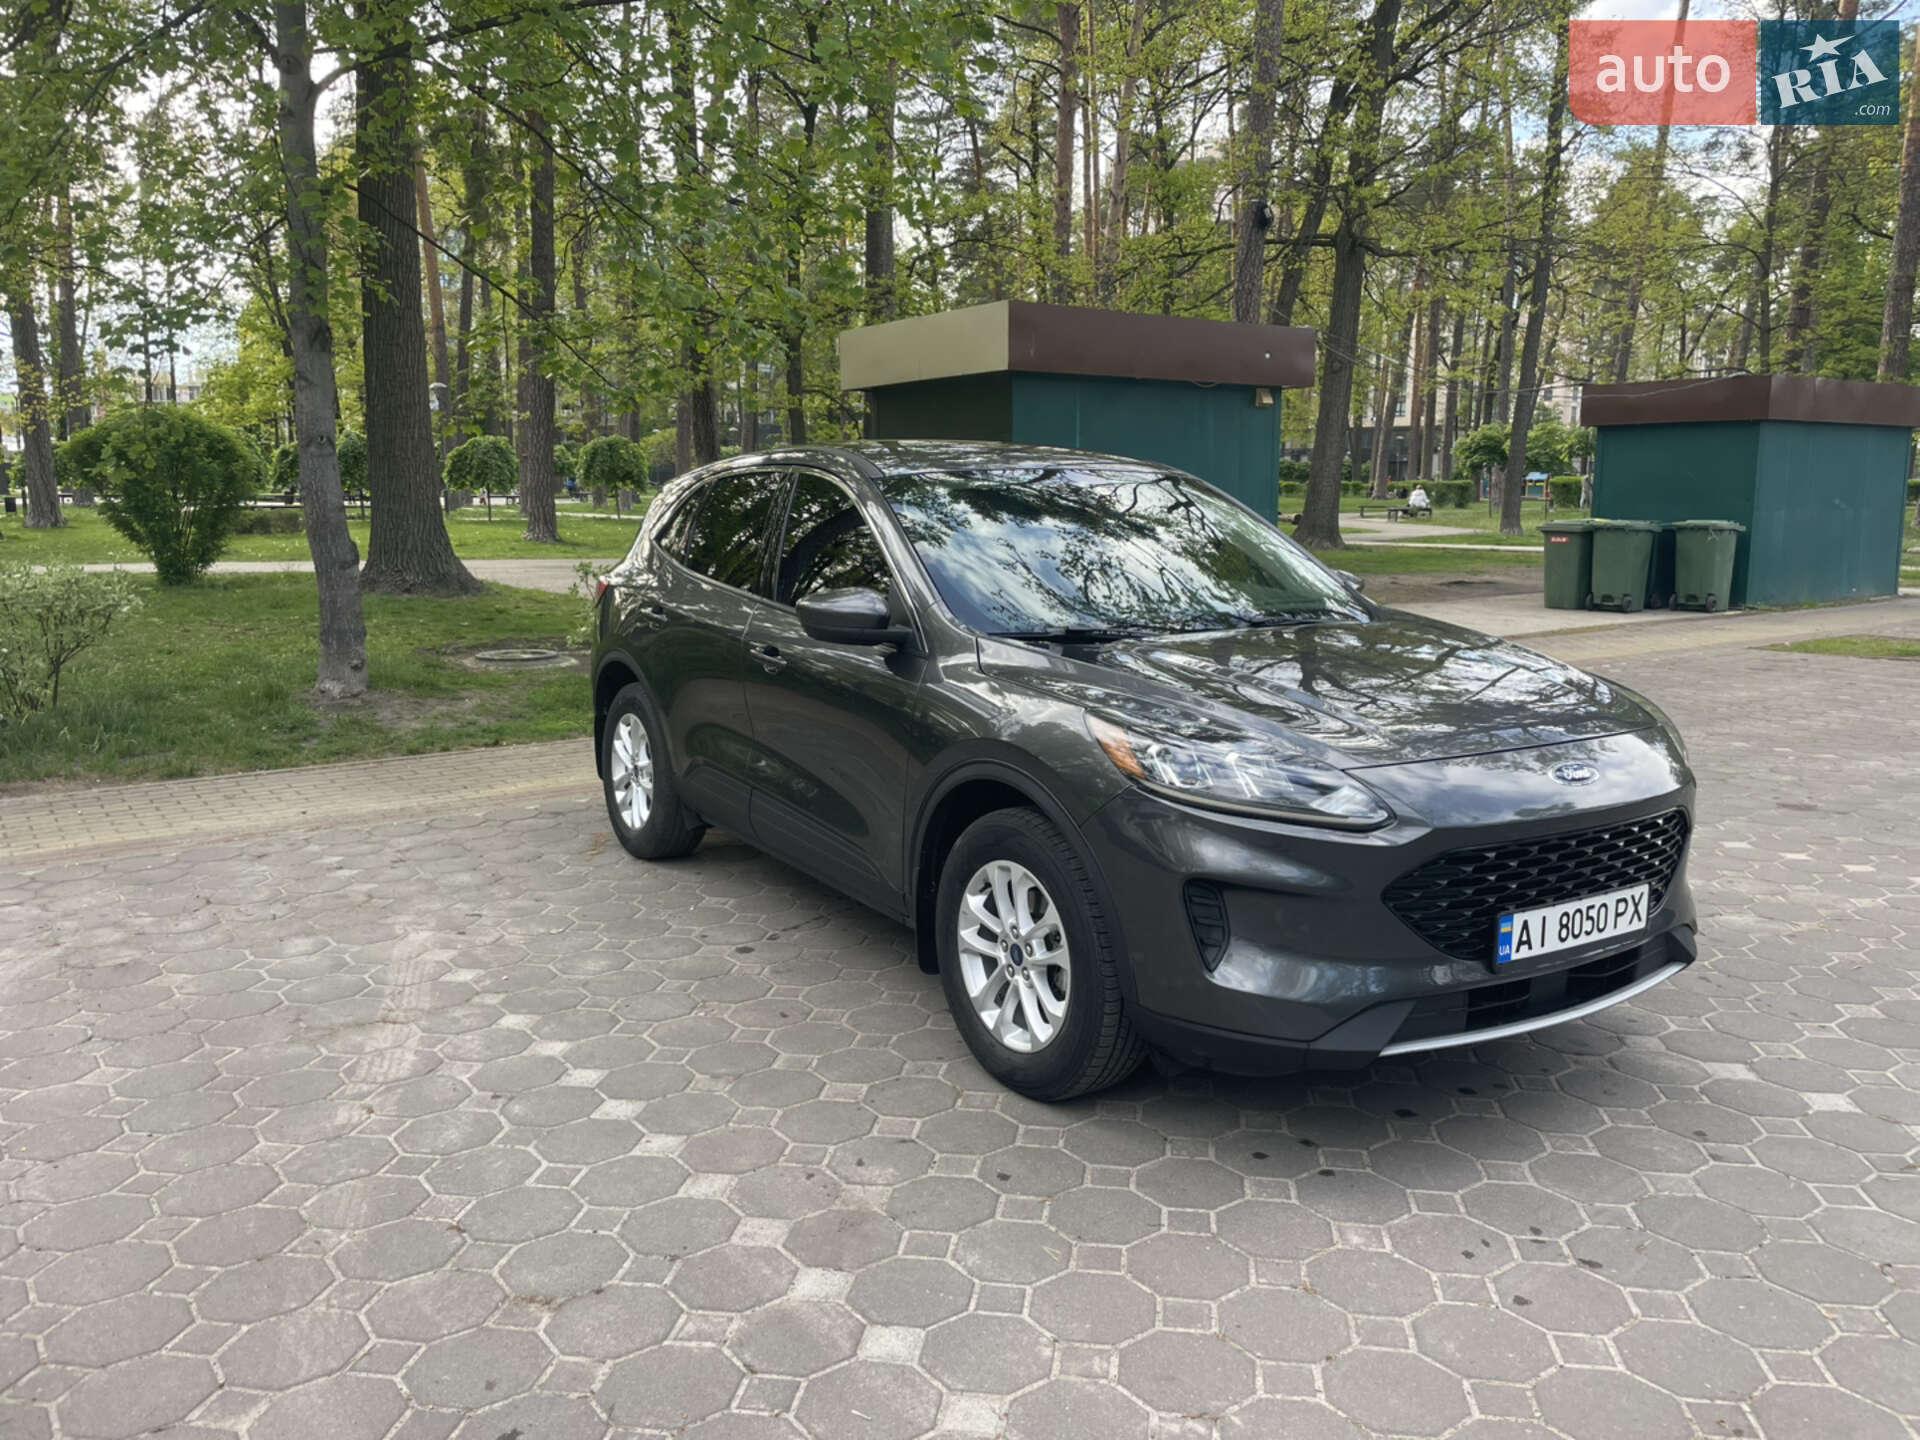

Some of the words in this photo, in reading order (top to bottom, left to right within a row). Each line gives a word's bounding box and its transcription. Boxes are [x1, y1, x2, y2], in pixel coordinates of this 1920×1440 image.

[1514, 915, 1547, 953] AI
[1558, 902, 1609, 943] 8050
[1613, 891, 1645, 930] PX
[1498, 943, 1511, 956] UA
